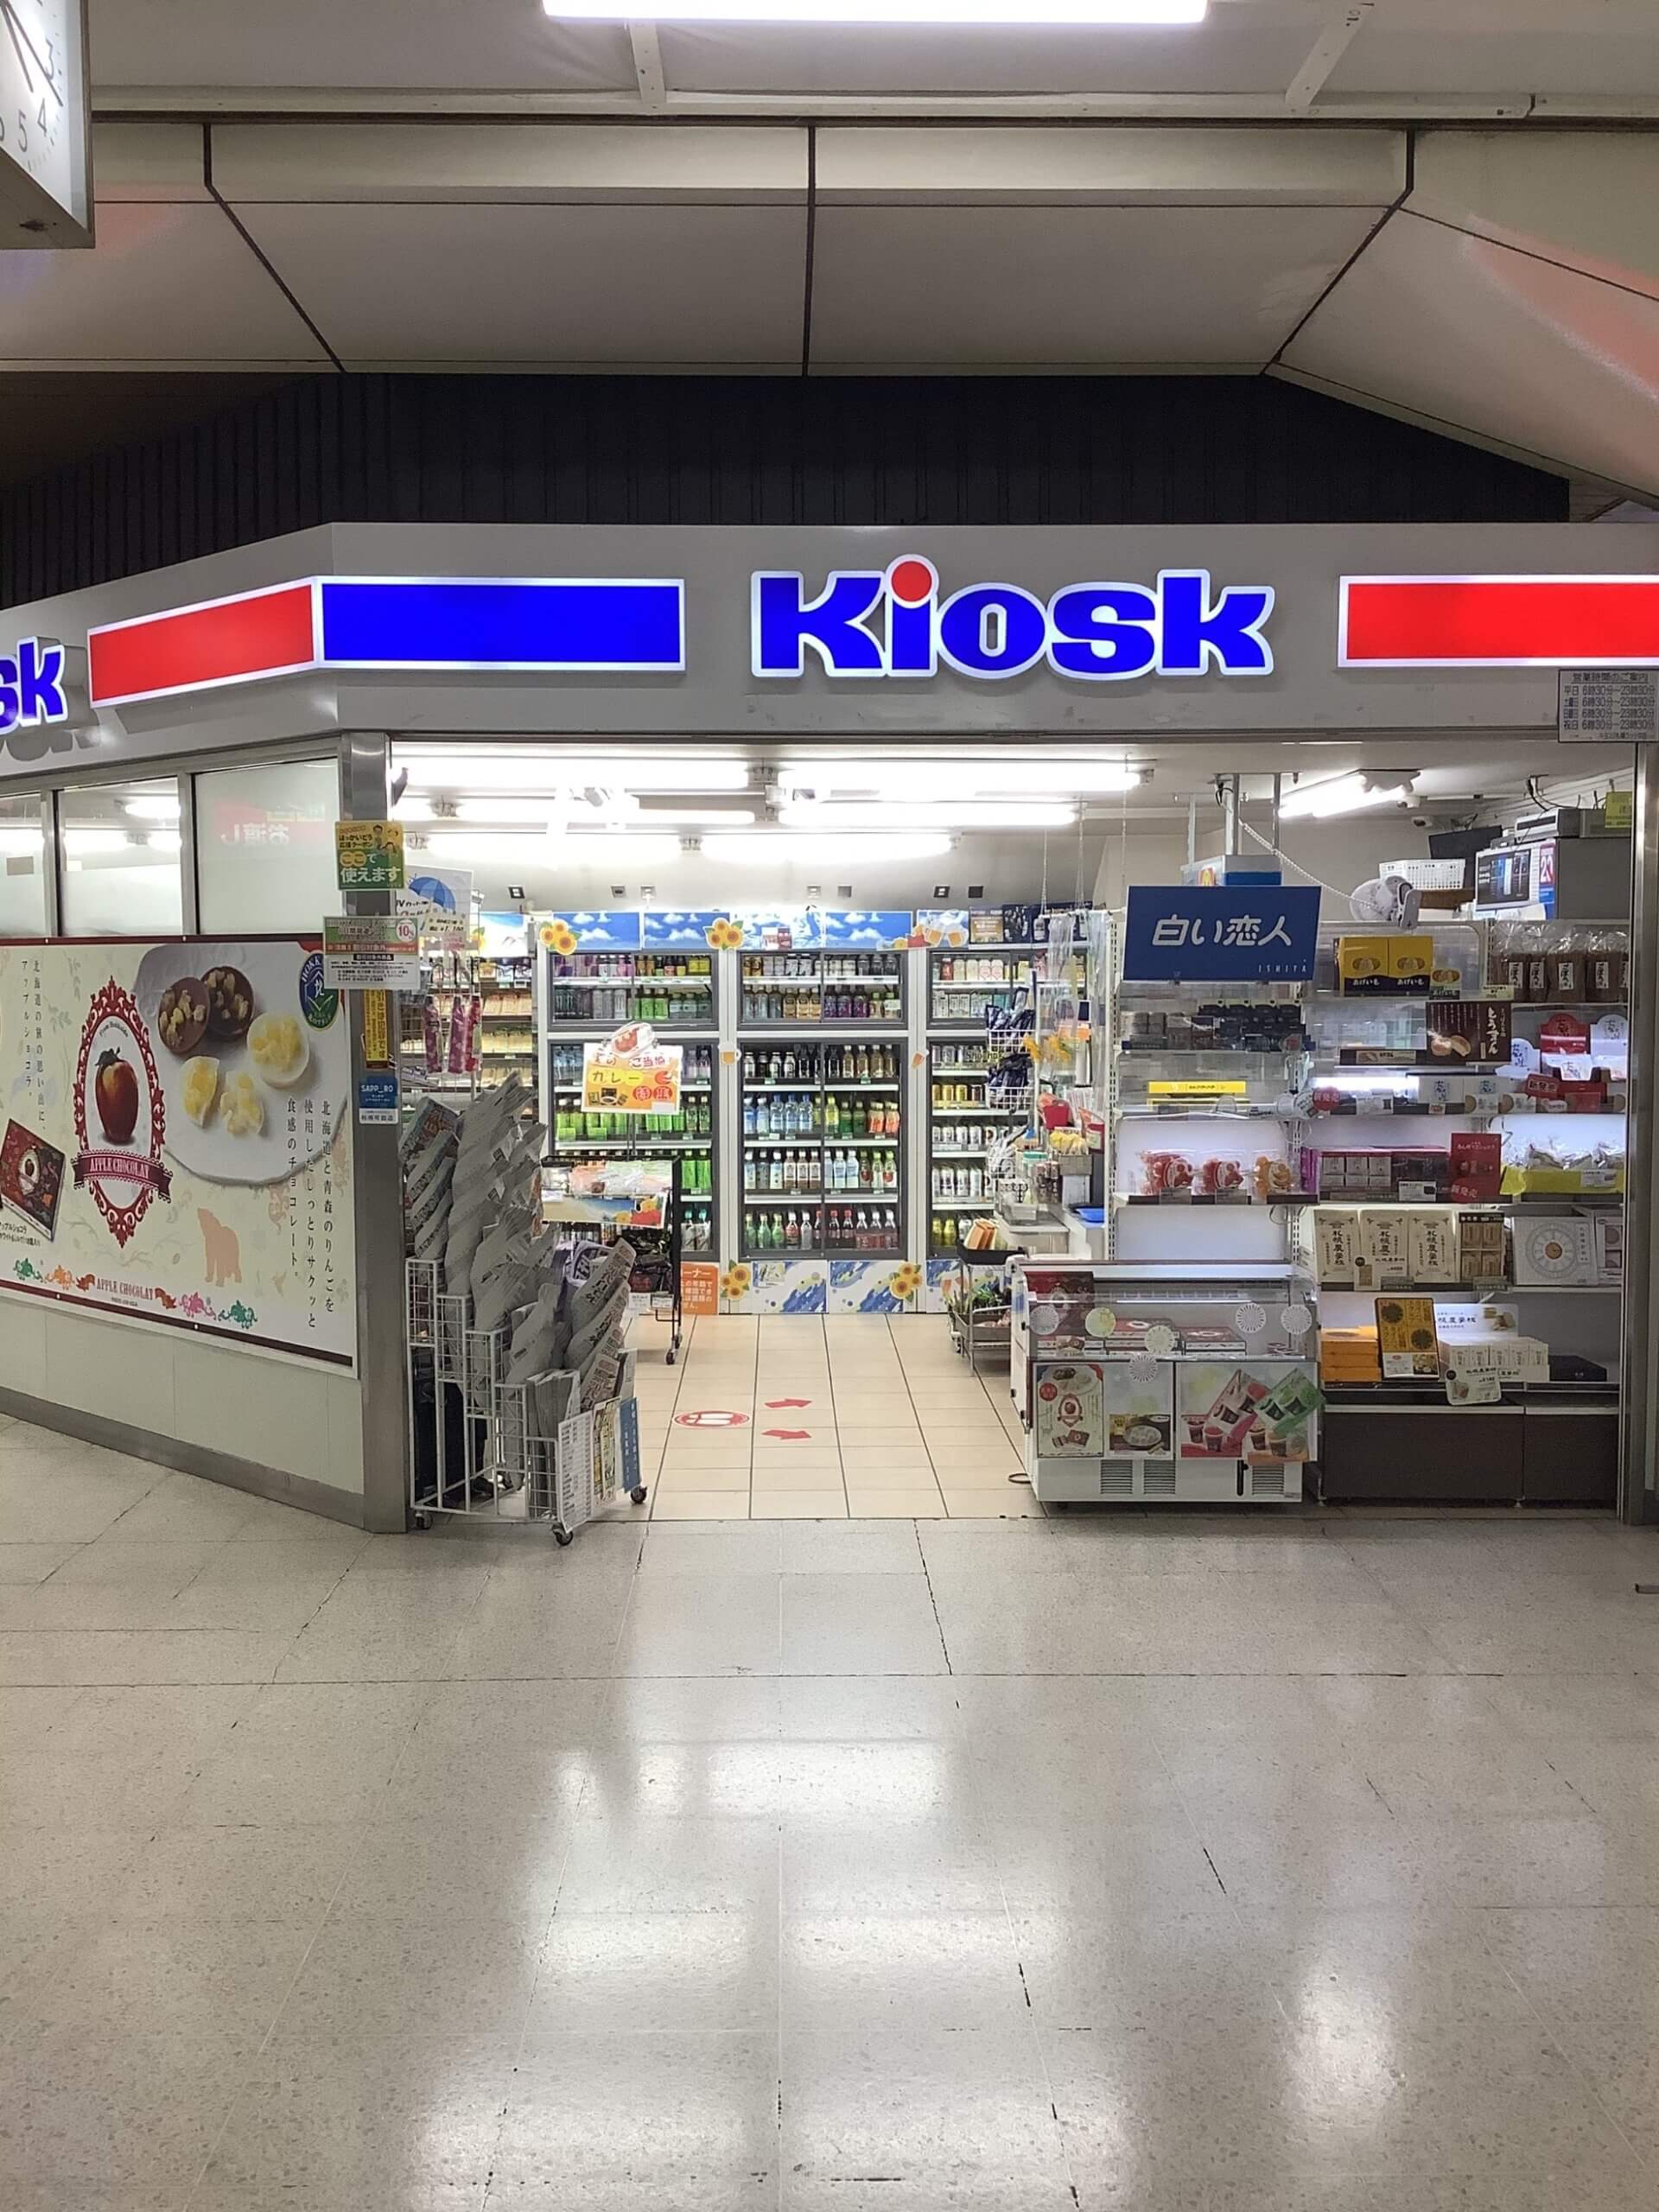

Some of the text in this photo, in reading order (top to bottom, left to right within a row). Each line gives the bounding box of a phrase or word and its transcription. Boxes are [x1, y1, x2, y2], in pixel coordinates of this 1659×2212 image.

[751, 554, 1274, 680] Kiosk
[340, 867, 401, 883] 使えます
[1152, 914, 1293, 946] 白い恋人
[593, 1071, 640, 1084] カレー
[635, 1086, 672, 1101] 特集
[90, 1158, 150, 1179] APPLE CHOCOLAT
[287, 1097, 299, 1277] 食感のチョコレート。
[303, 1098, 316, 1328] 使用したしっとりサクッと
[321, 1100, 335, 1313] 北海道と青森のりんごを
[97, 1278, 154, 1300] APPLE CHOCOLAT
